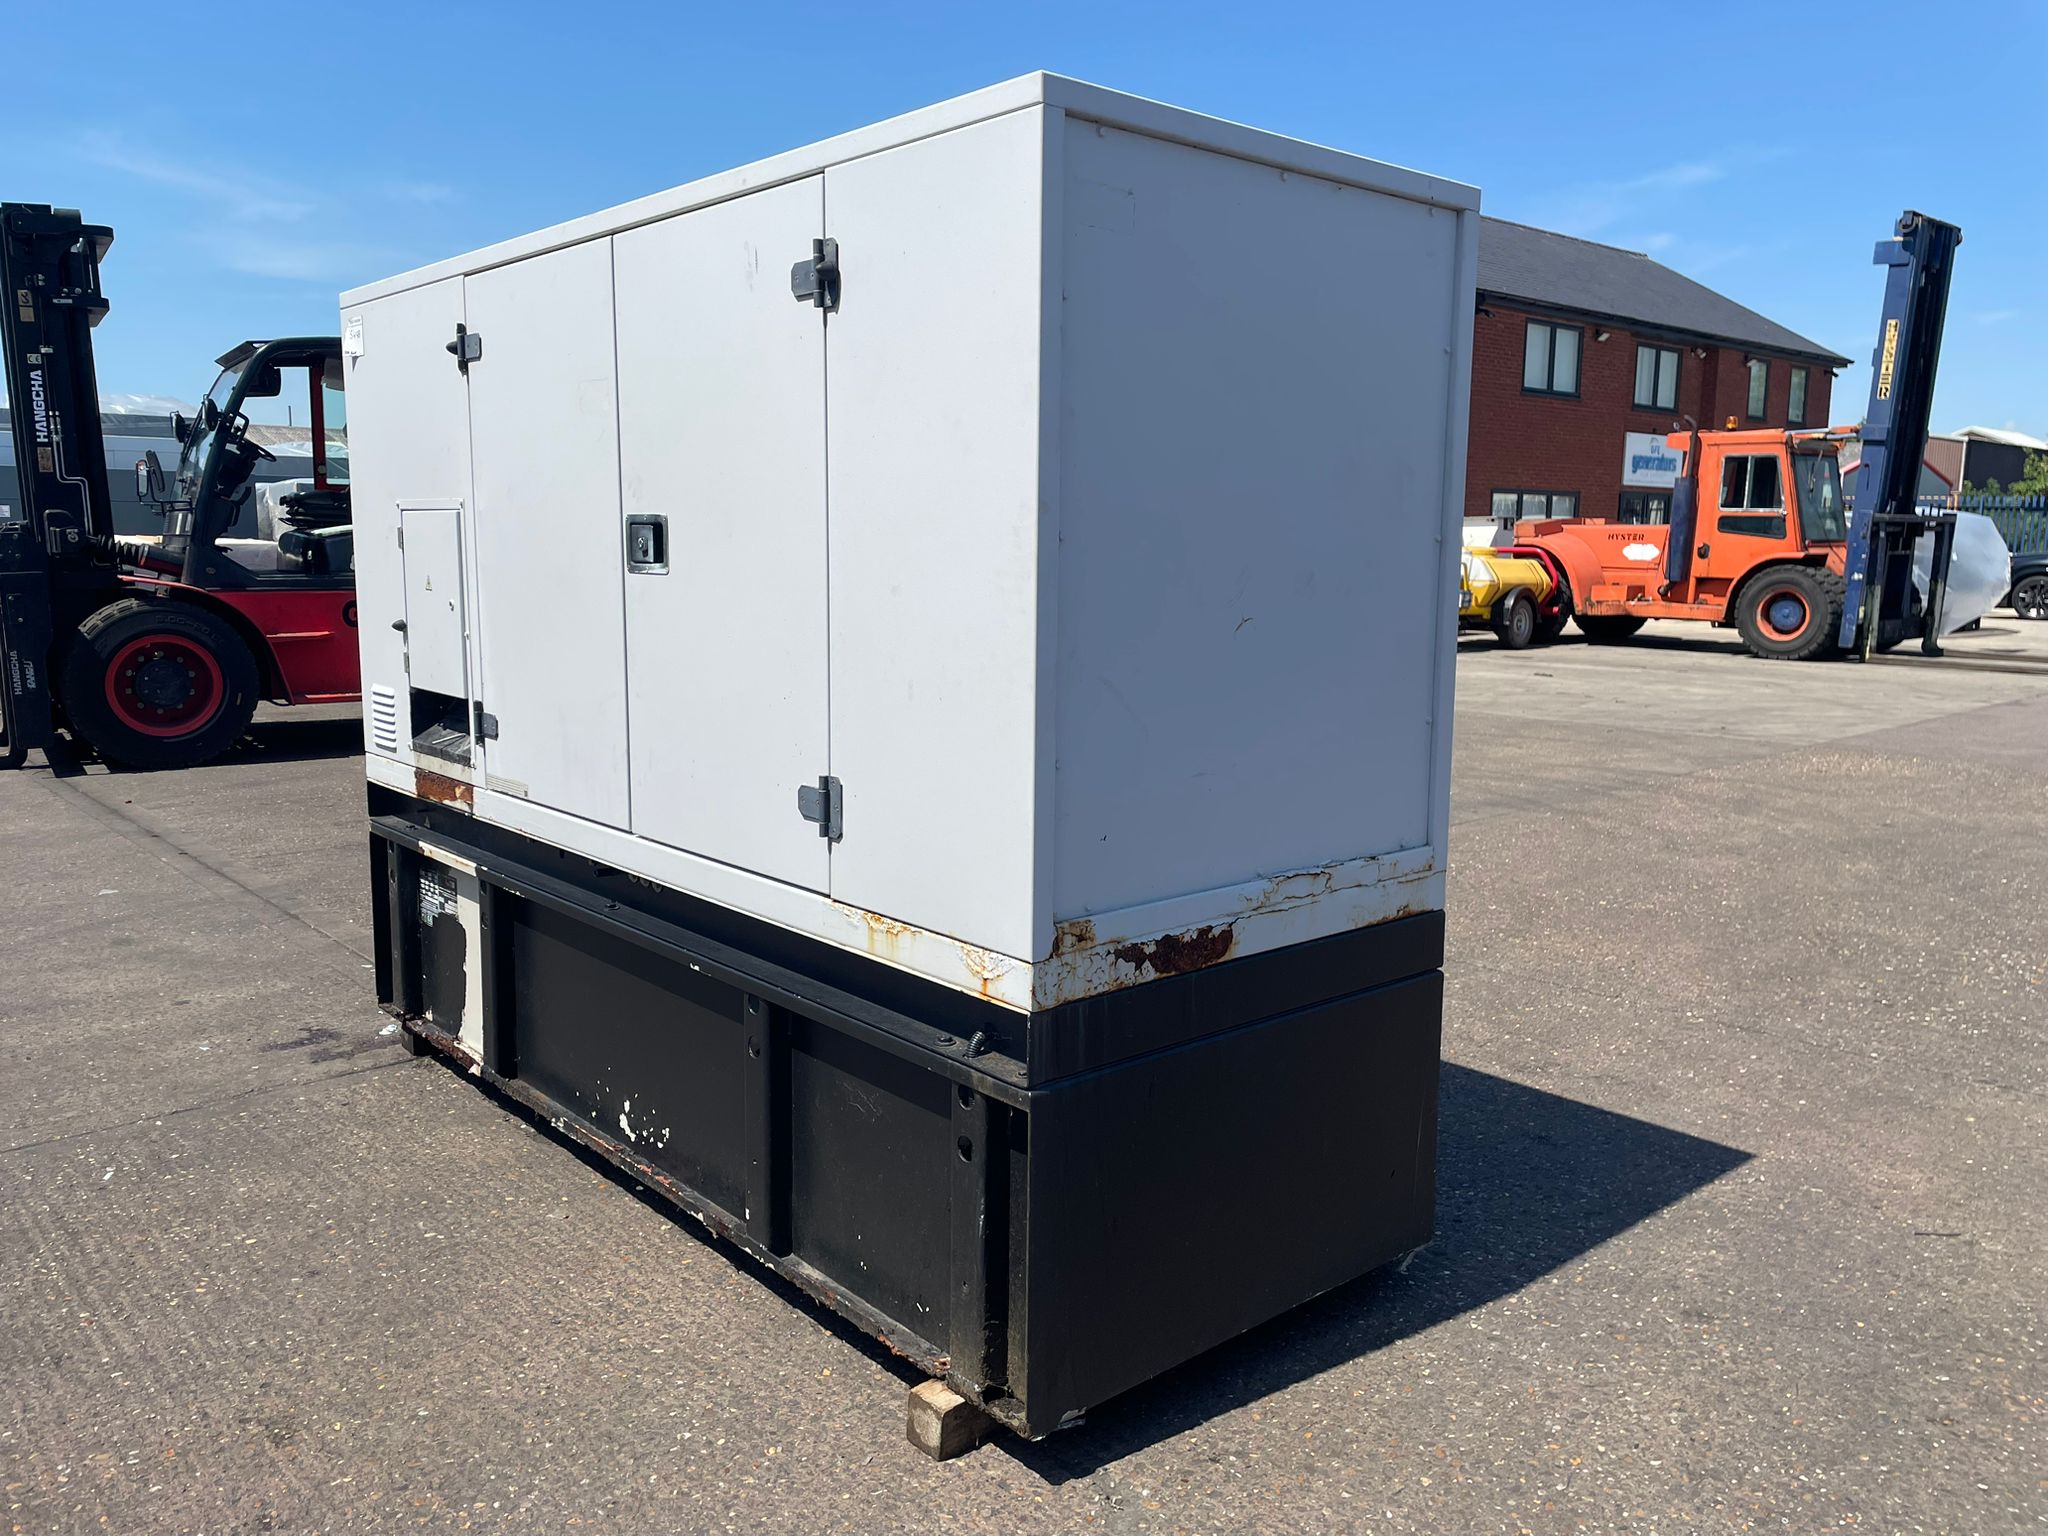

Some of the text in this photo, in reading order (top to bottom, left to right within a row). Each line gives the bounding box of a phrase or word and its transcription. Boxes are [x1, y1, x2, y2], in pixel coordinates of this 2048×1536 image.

[30, 370, 49, 442] HANGCHA
[1607, 533, 1645, 541] HYSTER
[9, 650, 22, 695] HANGCHA
